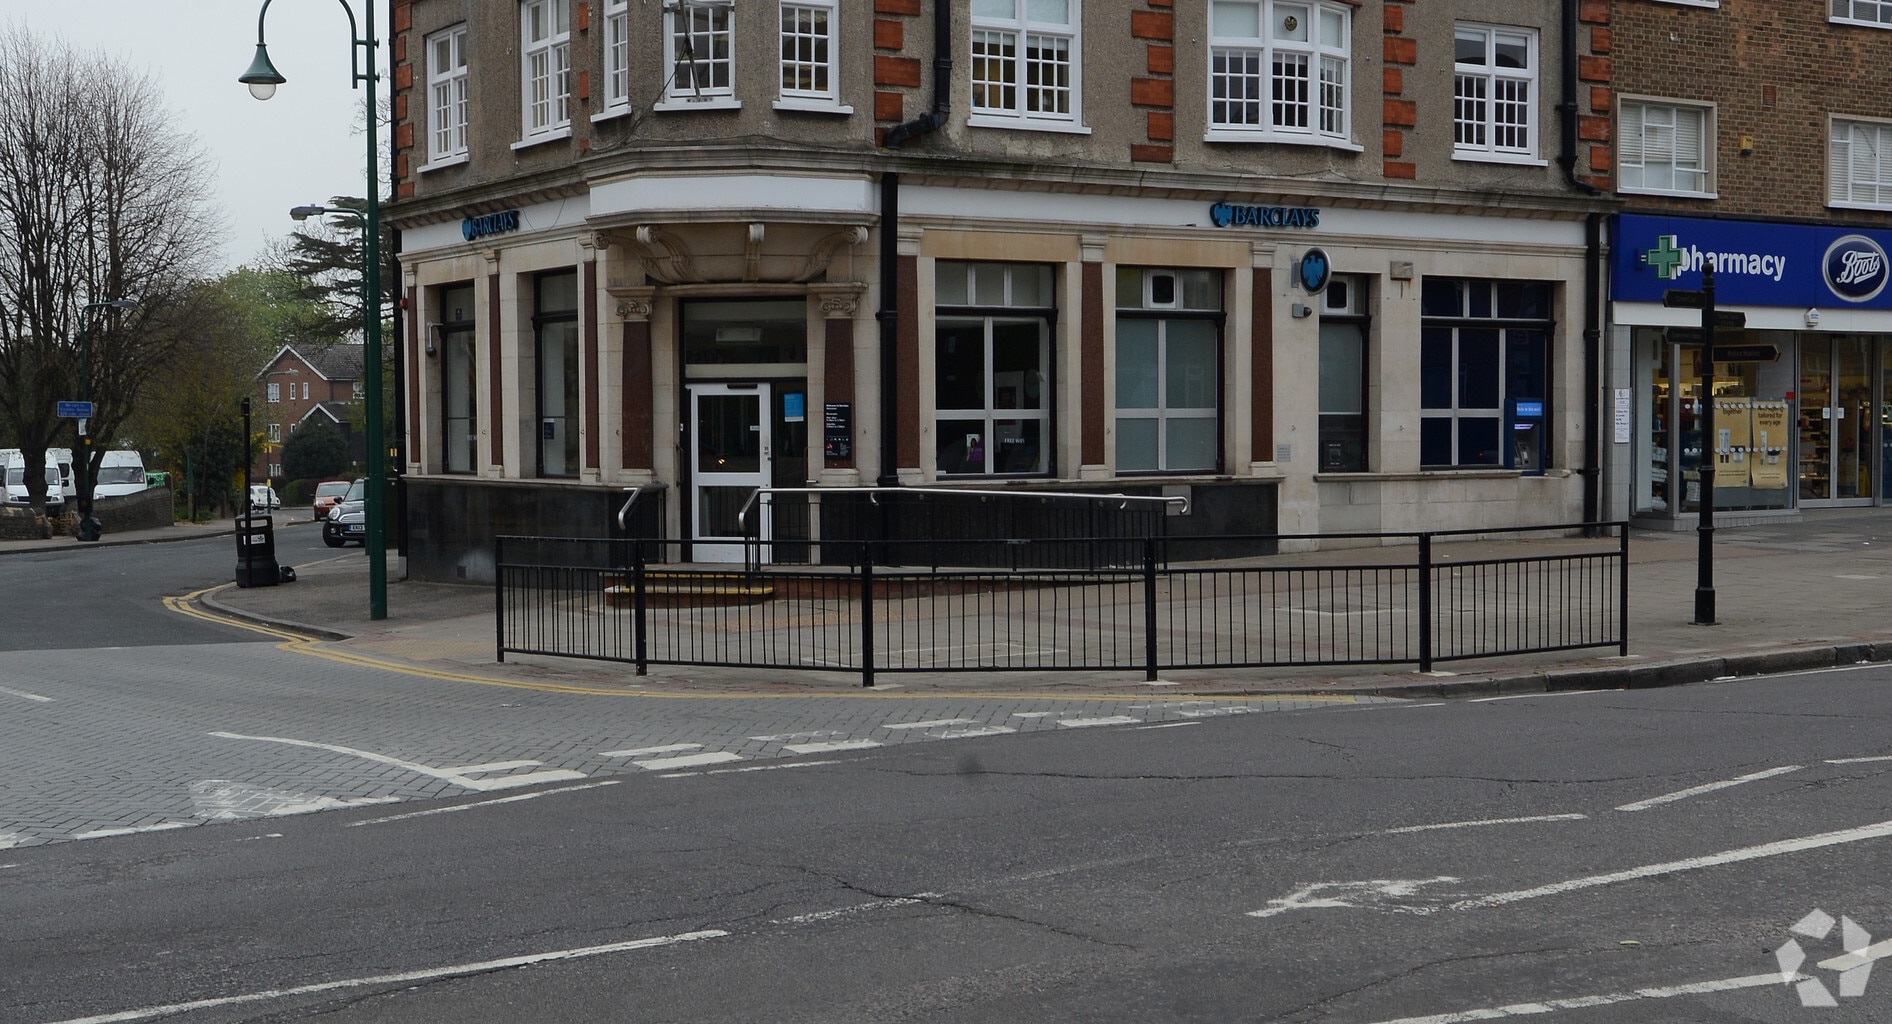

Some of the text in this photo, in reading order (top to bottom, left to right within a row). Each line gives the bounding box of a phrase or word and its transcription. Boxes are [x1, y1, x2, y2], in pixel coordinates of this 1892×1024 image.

[472, 210, 517, 236] BARCLAYS
[1234, 206, 1320, 227] BARCLAYS
[1836, 250, 1880, 285] Boots
